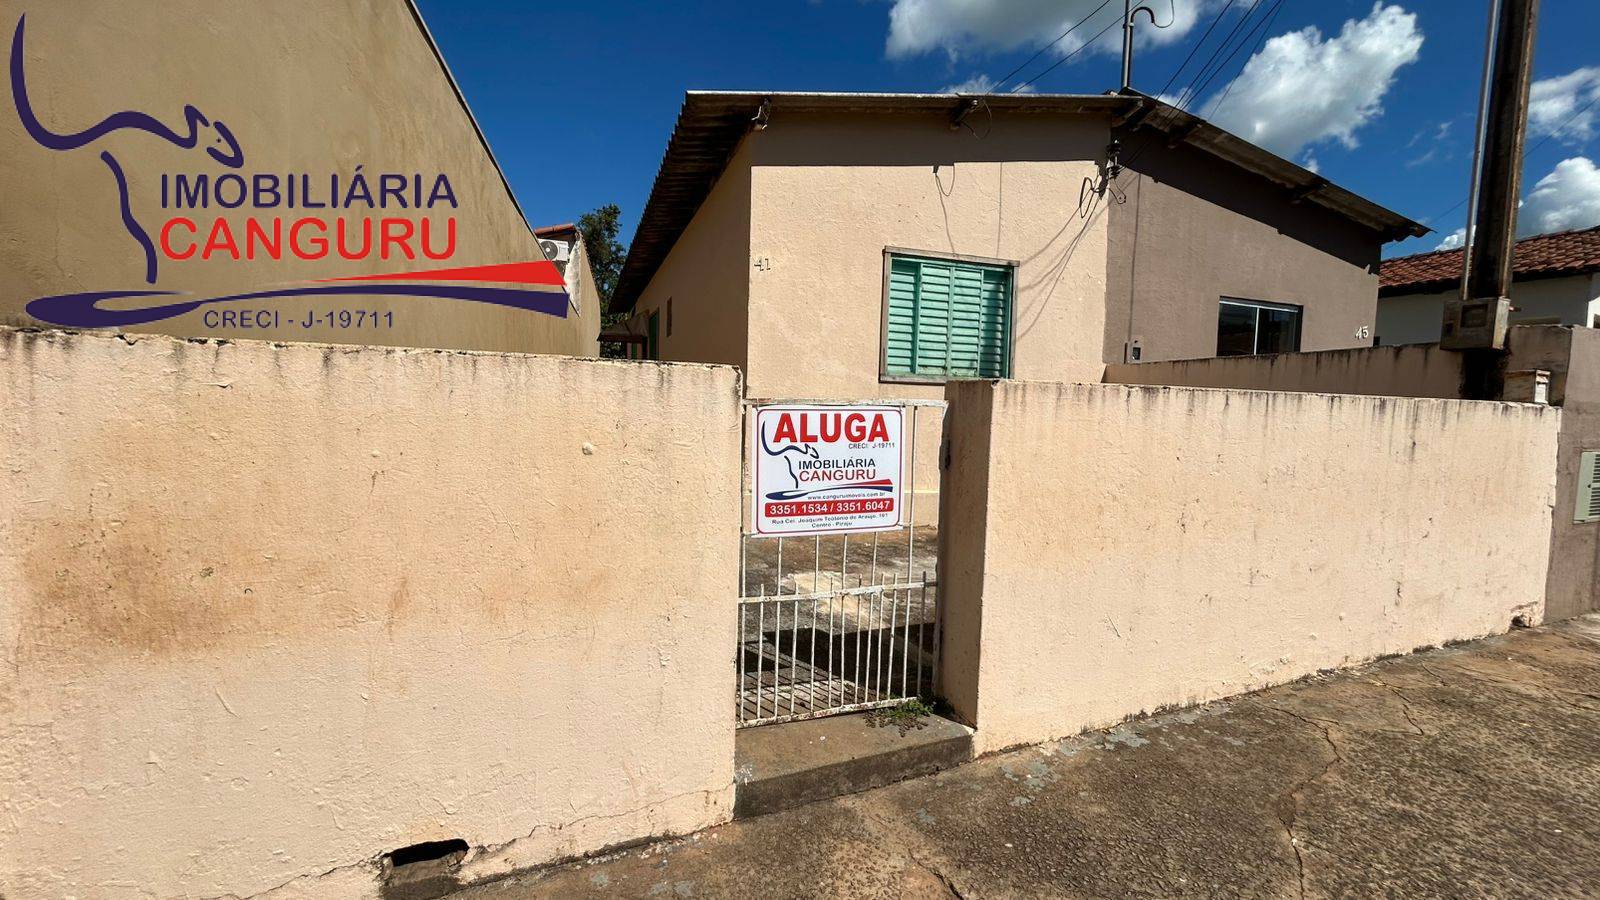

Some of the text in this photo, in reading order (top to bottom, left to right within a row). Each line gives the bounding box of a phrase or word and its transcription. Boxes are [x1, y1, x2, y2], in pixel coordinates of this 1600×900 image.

[753, 256, 771, 271] 41
[773, 413, 890, 443] ALUGA
[798, 457, 876, 470] IMOBILIÁRIA
[799, 469, 876, 482] CANGURU
[769, 503, 828, 515] 3351.1534
[836, 500, 890, 512] 3351.6047
